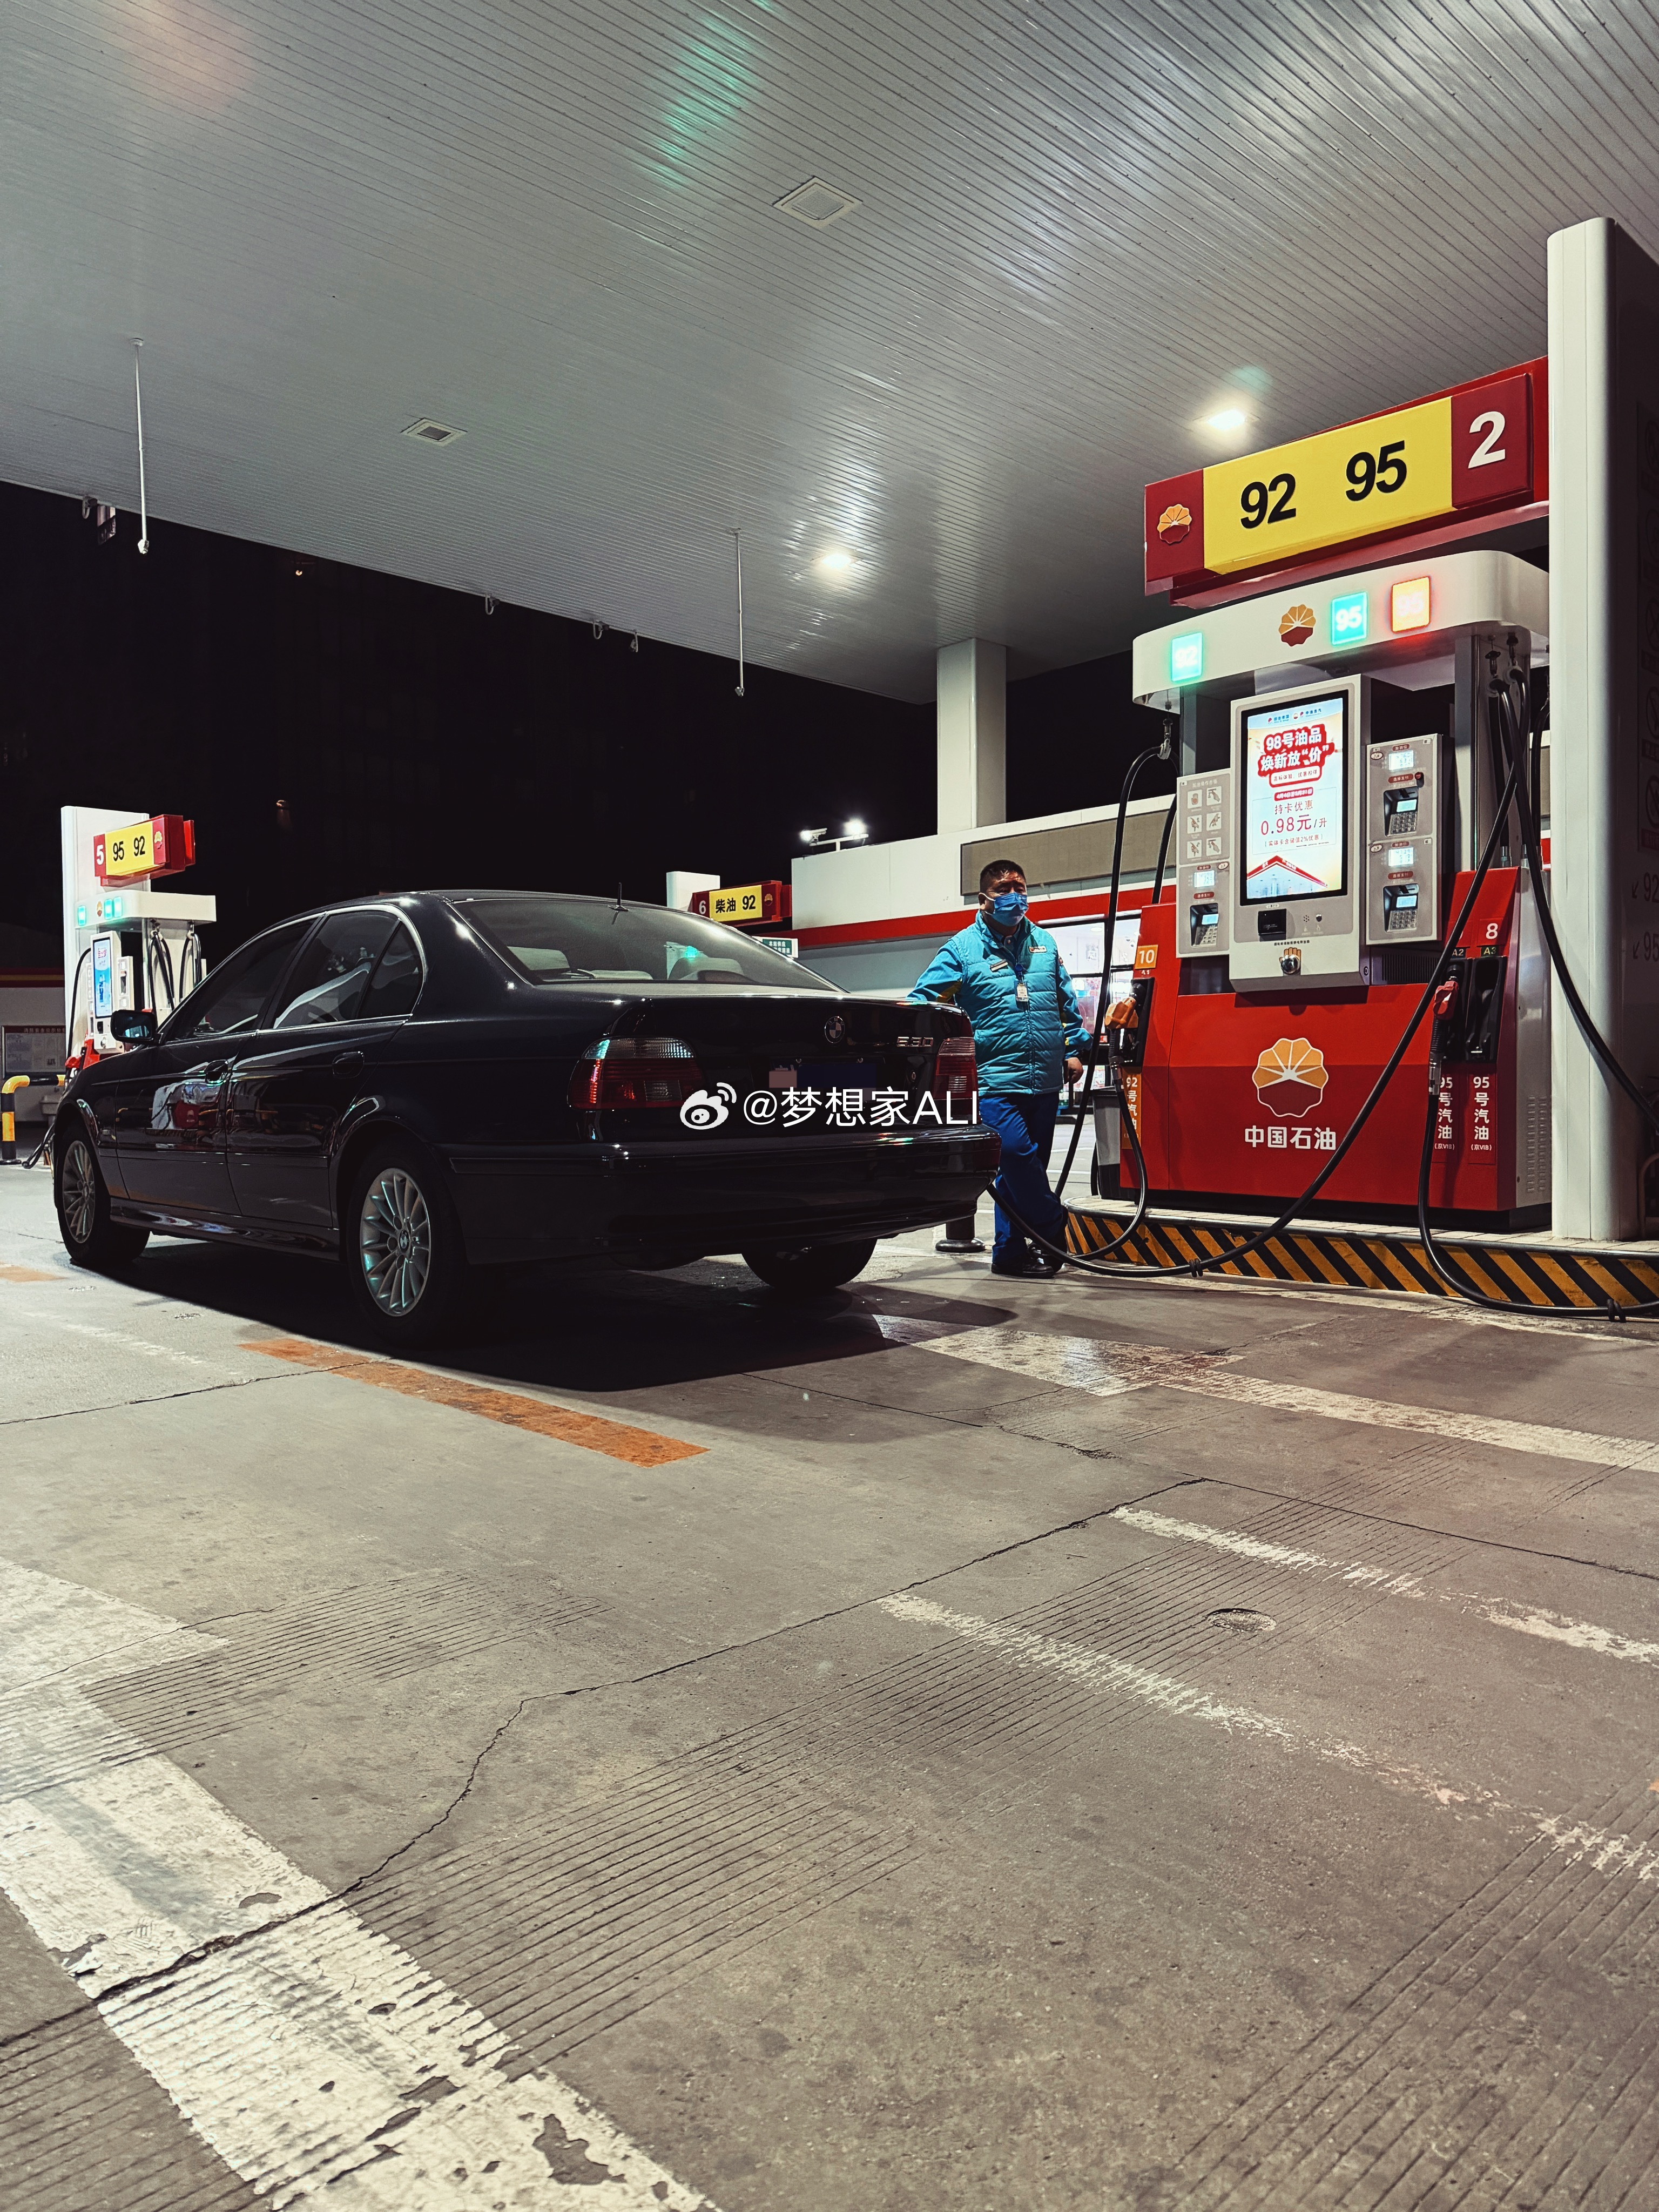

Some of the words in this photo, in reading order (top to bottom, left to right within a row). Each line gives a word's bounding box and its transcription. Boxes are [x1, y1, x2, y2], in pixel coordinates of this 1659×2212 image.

[1467, 411, 1506, 469] 2
[1240, 473, 1297, 529] 92
[1345, 440, 1407, 502] 95
[1174, 645, 1198, 668] 92
[1335, 605, 1363, 631] 95
[1395, 591, 1424, 617] 95
[1266, 727, 1322, 751] 98号油品
[1274, 800, 1313, 814] 持卡优惠
[1261, 814, 1327, 835] 0.98元/升
[96, 844, 104, 865] 5
[112, 841, 125, 861] 95
[133, 835, 146, 857] 92
[699, 900, 706, 914] 6
[715, 898, 736, 913] 柴油
[742, 895, 756, 910] 92
[1486, 923, 1498, 940] 8
[1139, 949, 1155, 964] 10
[1483, 947, 1496, 955] A3
[1473, 1076, 1490, 1140] 95号汽油
[1245, 1125, 1336, 1150] 中国石油
